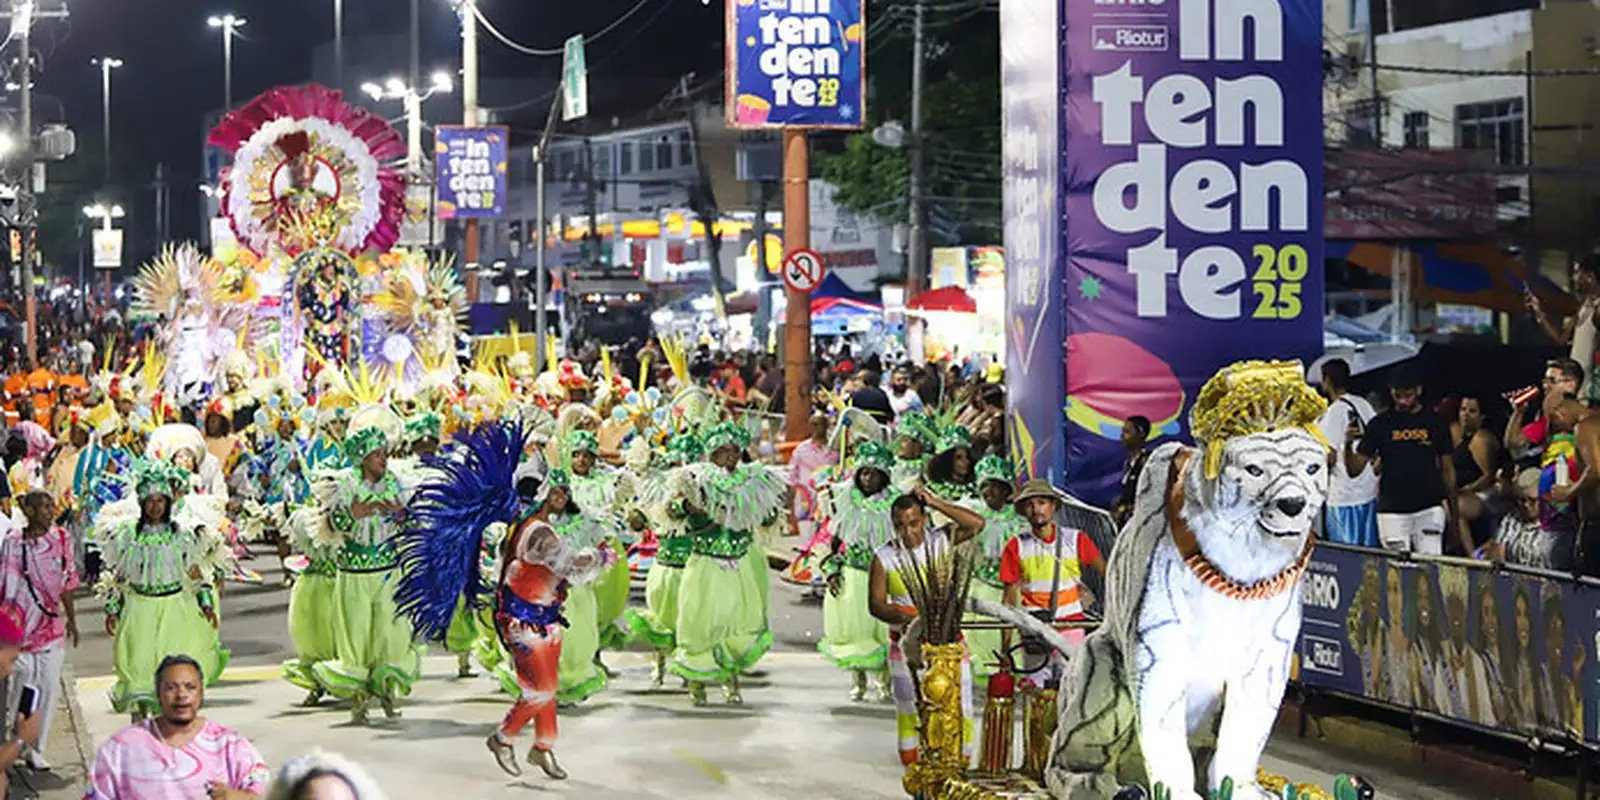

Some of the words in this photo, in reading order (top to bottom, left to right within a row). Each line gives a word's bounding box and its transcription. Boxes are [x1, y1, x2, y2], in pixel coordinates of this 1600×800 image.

[758, 11, 831, 45] ten
[1116, 29, 1164, 46] Riotur
[759, 41, 839, 76] den
[772, 73, 817, 107] te
[1092, 58, 1284, 147] ten
[449, 173, 495, 192] den
[1092, 143, 1308, 233] den
[1127, 231, 1246, 319] te
[1252, 244, 1308, 281] 20
[1252, 282, 1302, 318] 25
[1391, 429, 1428, 440] BOSS
